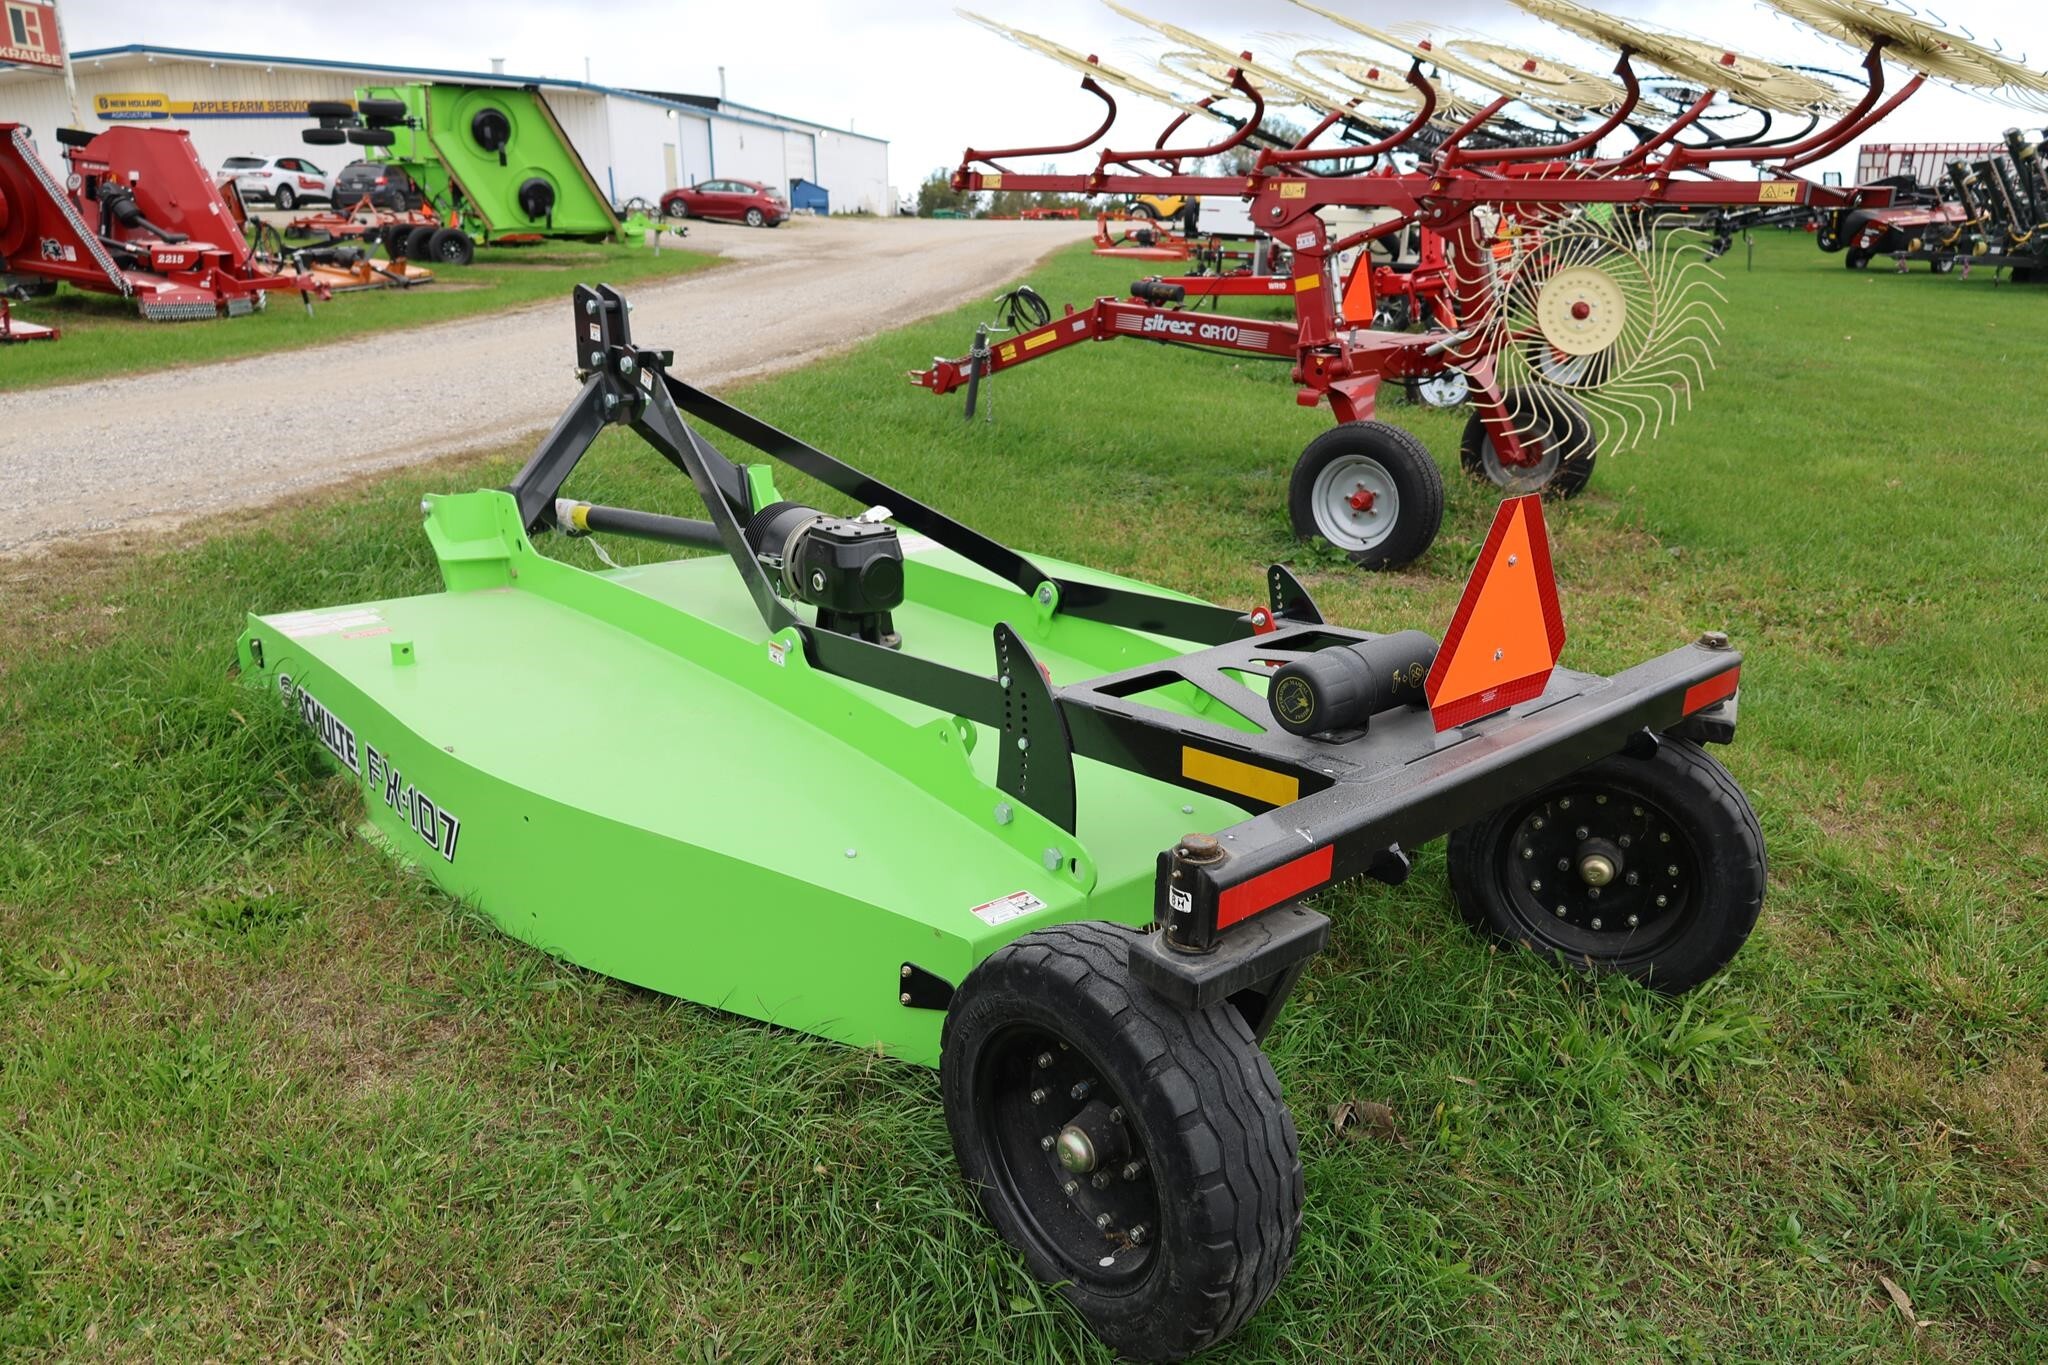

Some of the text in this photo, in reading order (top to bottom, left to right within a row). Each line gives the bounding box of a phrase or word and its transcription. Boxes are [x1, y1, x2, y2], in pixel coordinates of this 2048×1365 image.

[0, 47, 63, 66] KRAUSE
[110, 99, 162, 107] NEW HOLLAND
[192, 100, 309, 112] APPLE FARM SERVIC
[157, 254, 185, 264] 2215
[1143, 314, 1239, 342] sitrex QR10
